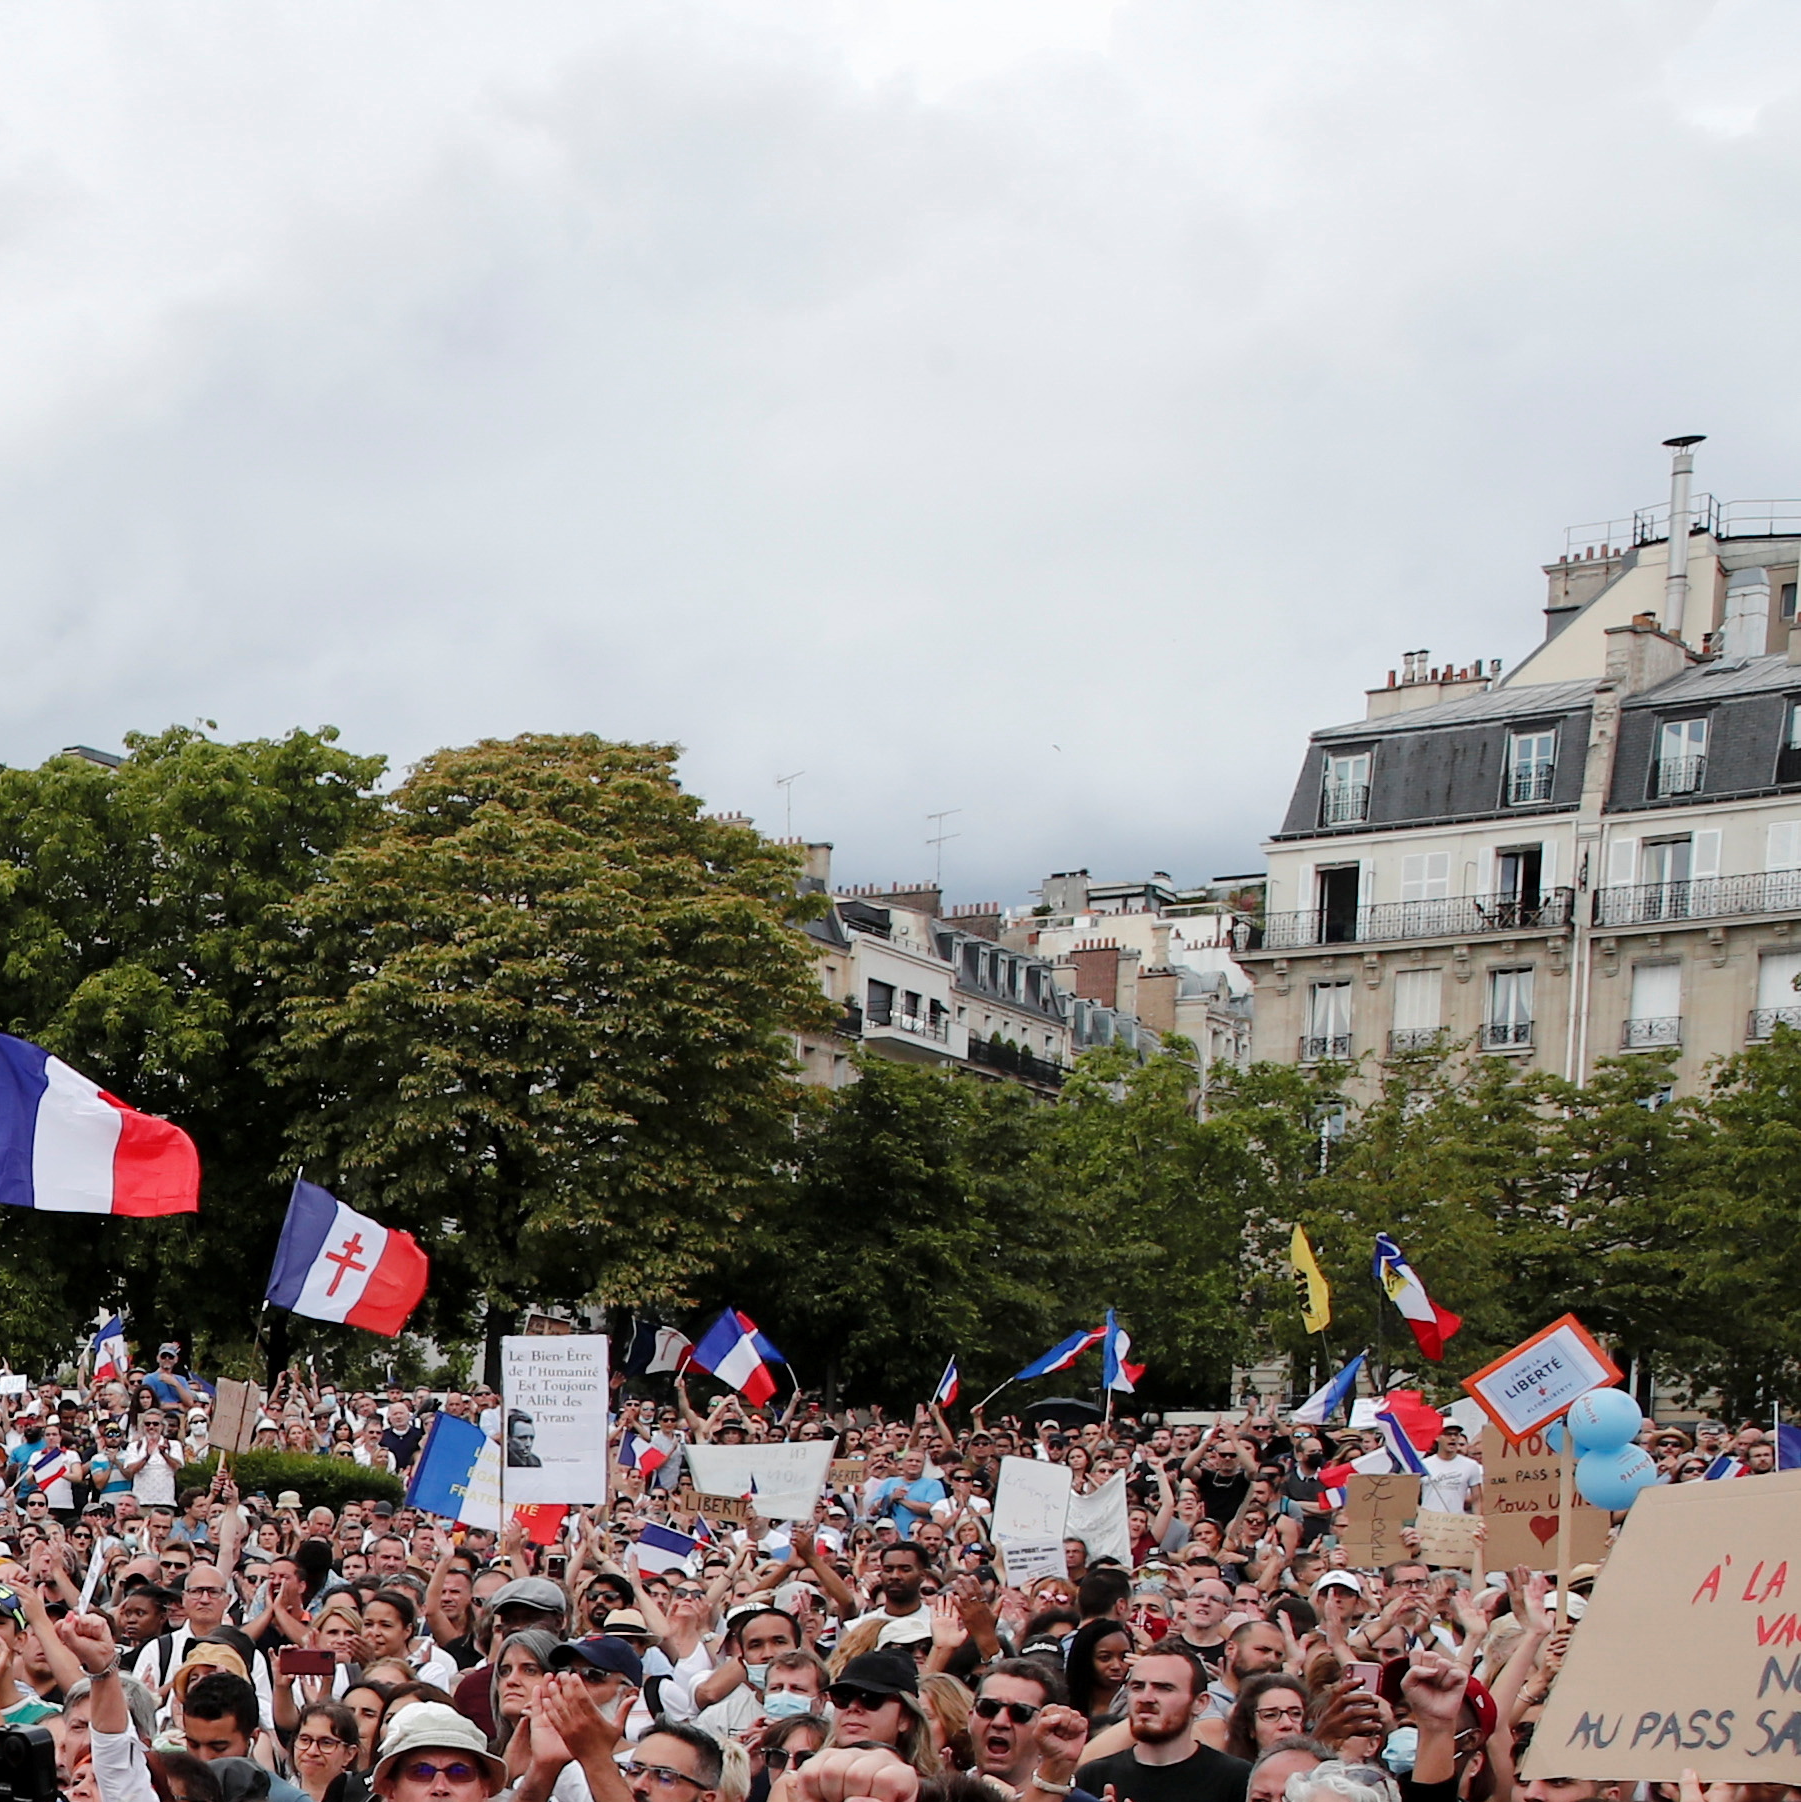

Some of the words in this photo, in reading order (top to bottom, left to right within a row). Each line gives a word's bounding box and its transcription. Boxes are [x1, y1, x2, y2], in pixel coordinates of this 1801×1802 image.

[509, 1350, 525, 1362] Le
[508, 1366, 524, 1377] de
[1504, 1356, 1563, 1400] LIBERTÉ
[518, 1380, 537, 1391] Est
[541, 1380, 598, 1394] Toujours
[562, 1395, 582, 1407] des
[533, 1411, 575, 1424] Tyrans
[1515, 1470, 1547, 1482] PASS
[1494, 1493, 1539, 1513] tous
[1742, 1560, 1787, 1604] LA
[1565, 1711, 1623, 1750] AU
[1630, 1709, 1735, 1751] PASS
